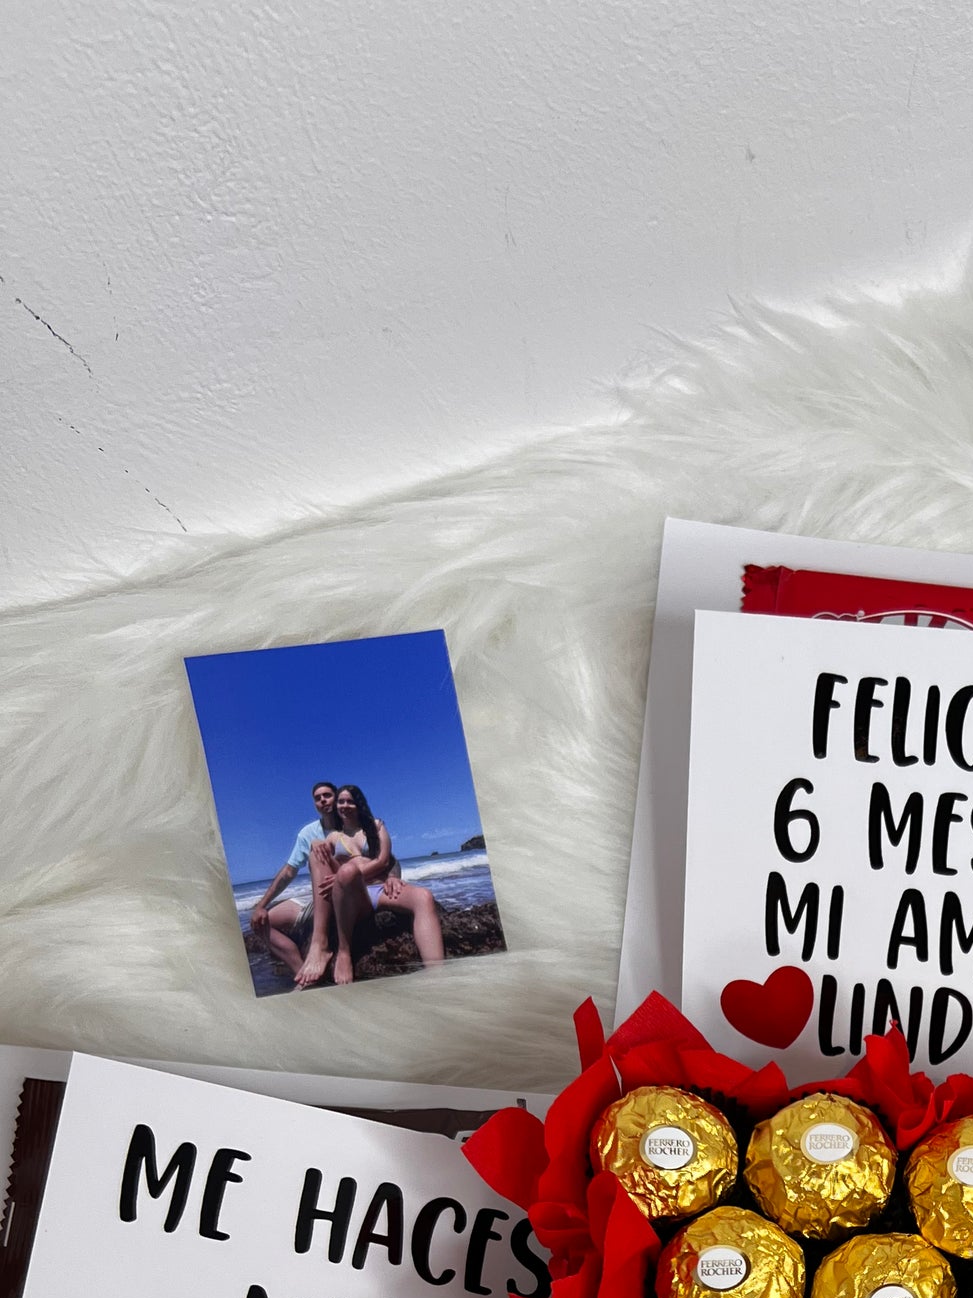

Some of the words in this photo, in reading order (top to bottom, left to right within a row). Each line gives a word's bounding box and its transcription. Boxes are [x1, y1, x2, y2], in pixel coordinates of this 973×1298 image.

[773, 777, 820, 863] 6
[765, 871, 844, 962] MI
[648, 1138, 690, 1148] FERRERO
[809, 1134, 850, 1143] FERRERO
[809, 1141, 850, 1150] ROCHER
[648, 1147, 689, 1157] ROCHER
[119, 1124, 252, 1241] ME
[701, 1259, 742, 1268] FERRERO
[701, 1267, 743, 1277] ROCHER
